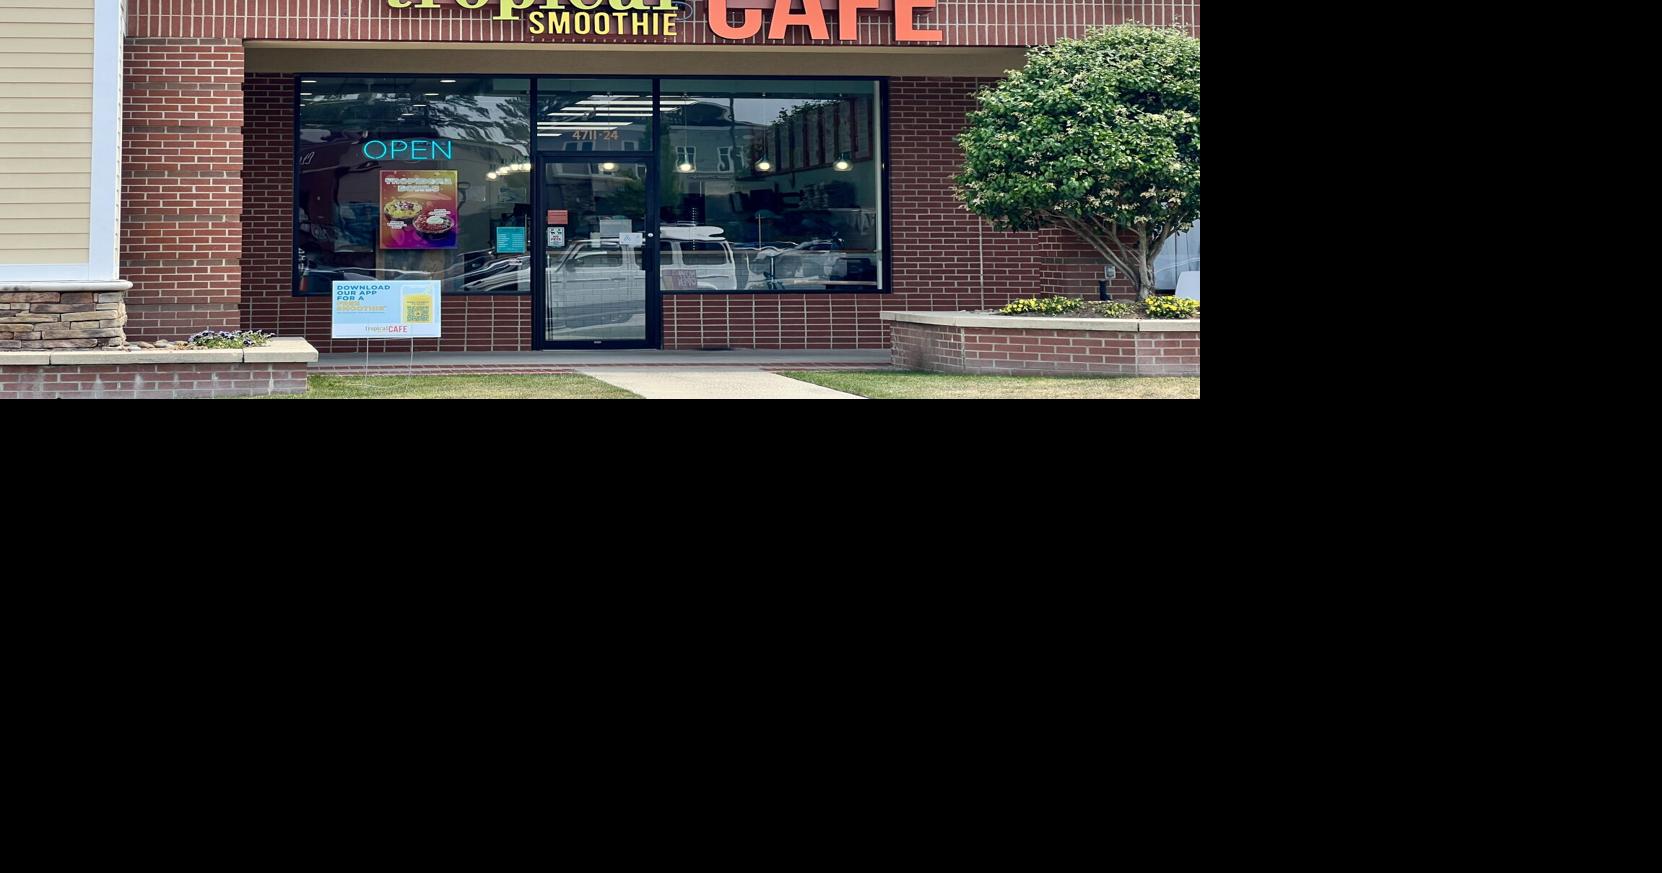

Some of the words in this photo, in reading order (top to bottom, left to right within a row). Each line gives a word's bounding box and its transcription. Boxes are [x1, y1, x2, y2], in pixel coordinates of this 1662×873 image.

[529, 11, 678, 36] SMOOTHIE
[363, 140, 453, 160] OPEN
[388, 325, 408, 333] CAFE
